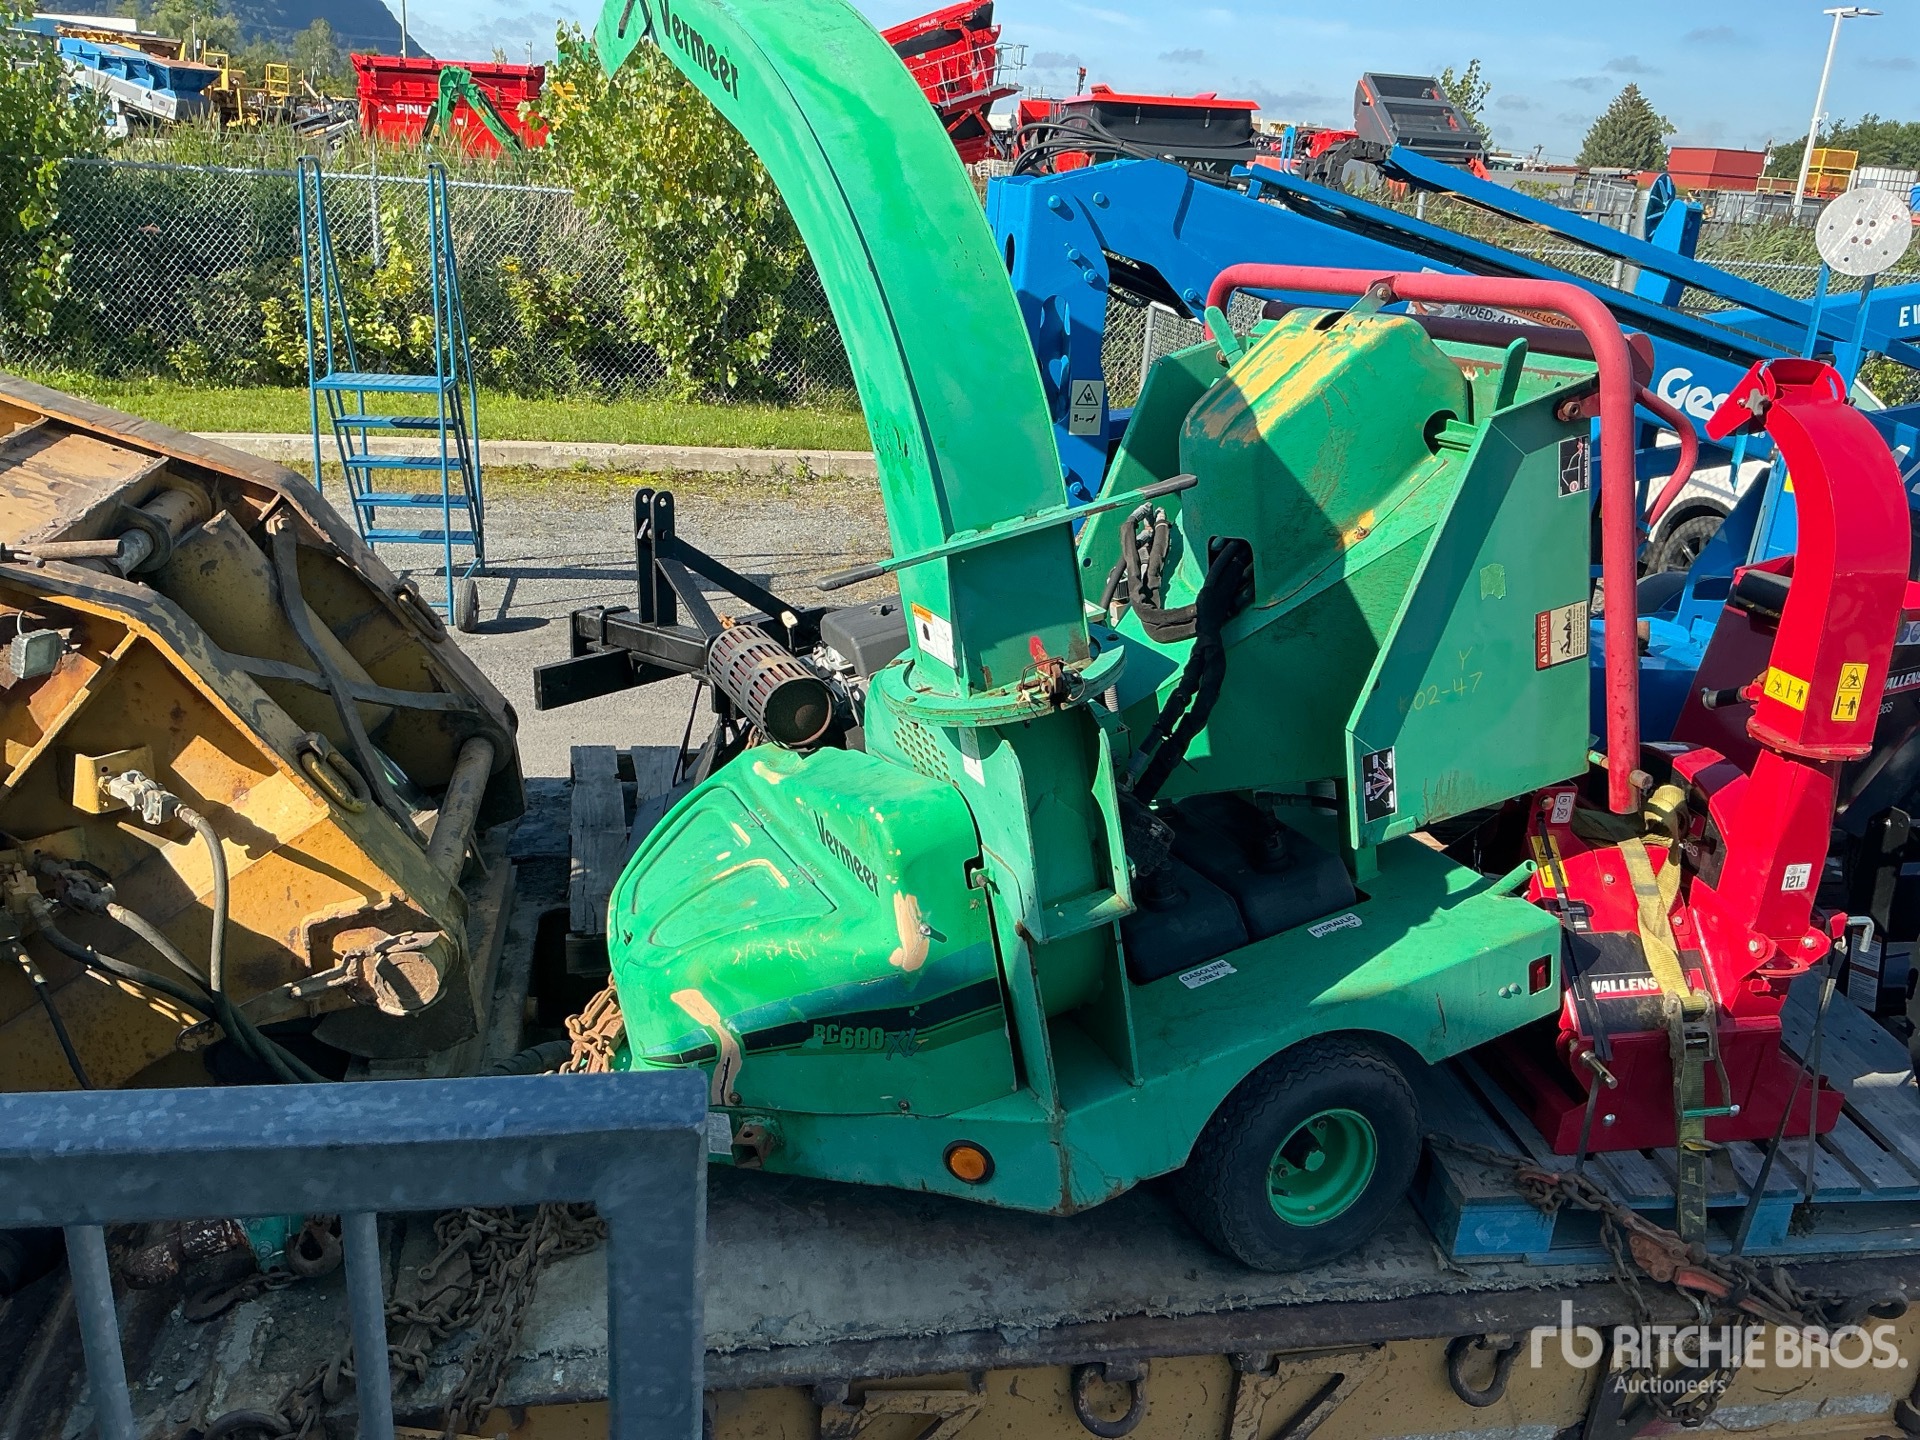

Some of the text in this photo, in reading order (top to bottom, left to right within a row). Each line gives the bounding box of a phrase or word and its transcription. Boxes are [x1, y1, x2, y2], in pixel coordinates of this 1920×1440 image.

[659, 0, 739, 101] Vermeer
[1656, 366, 1730, 421] Ge
[1540, 614, 1549, 653] DANGER
[813, 809, 880, 898] Vermeer
[1785, 875, 1801, 889] 121
[1311, 915, 1356, 935] HYDRAULIC
[1181, 961, 1228, 982] GASOLINE
[1198, 971, 1220, 982] ONLY
